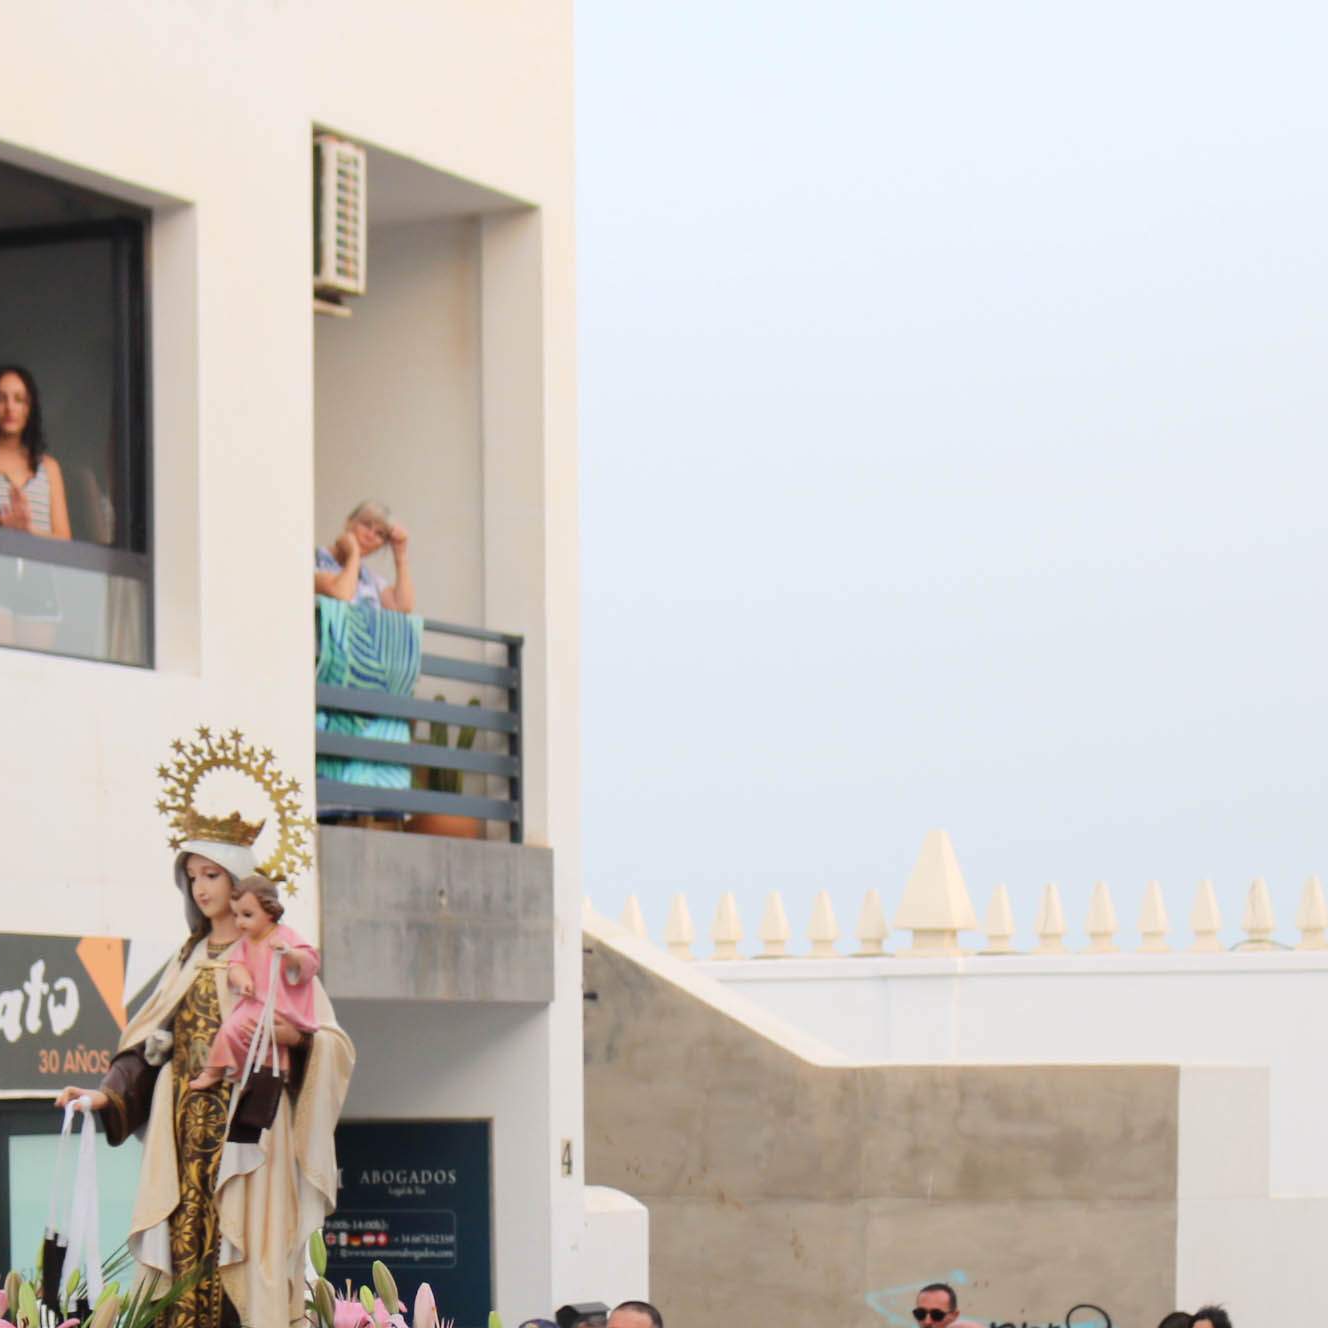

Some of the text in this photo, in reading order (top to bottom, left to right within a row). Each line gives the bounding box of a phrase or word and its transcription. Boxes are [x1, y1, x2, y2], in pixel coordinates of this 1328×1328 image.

[38, 1043, 111, 1073] 30 AÑOS
[561, 1139, 572, 1175] 4
[358, 1168, 457, 1185] ABOGADOS
